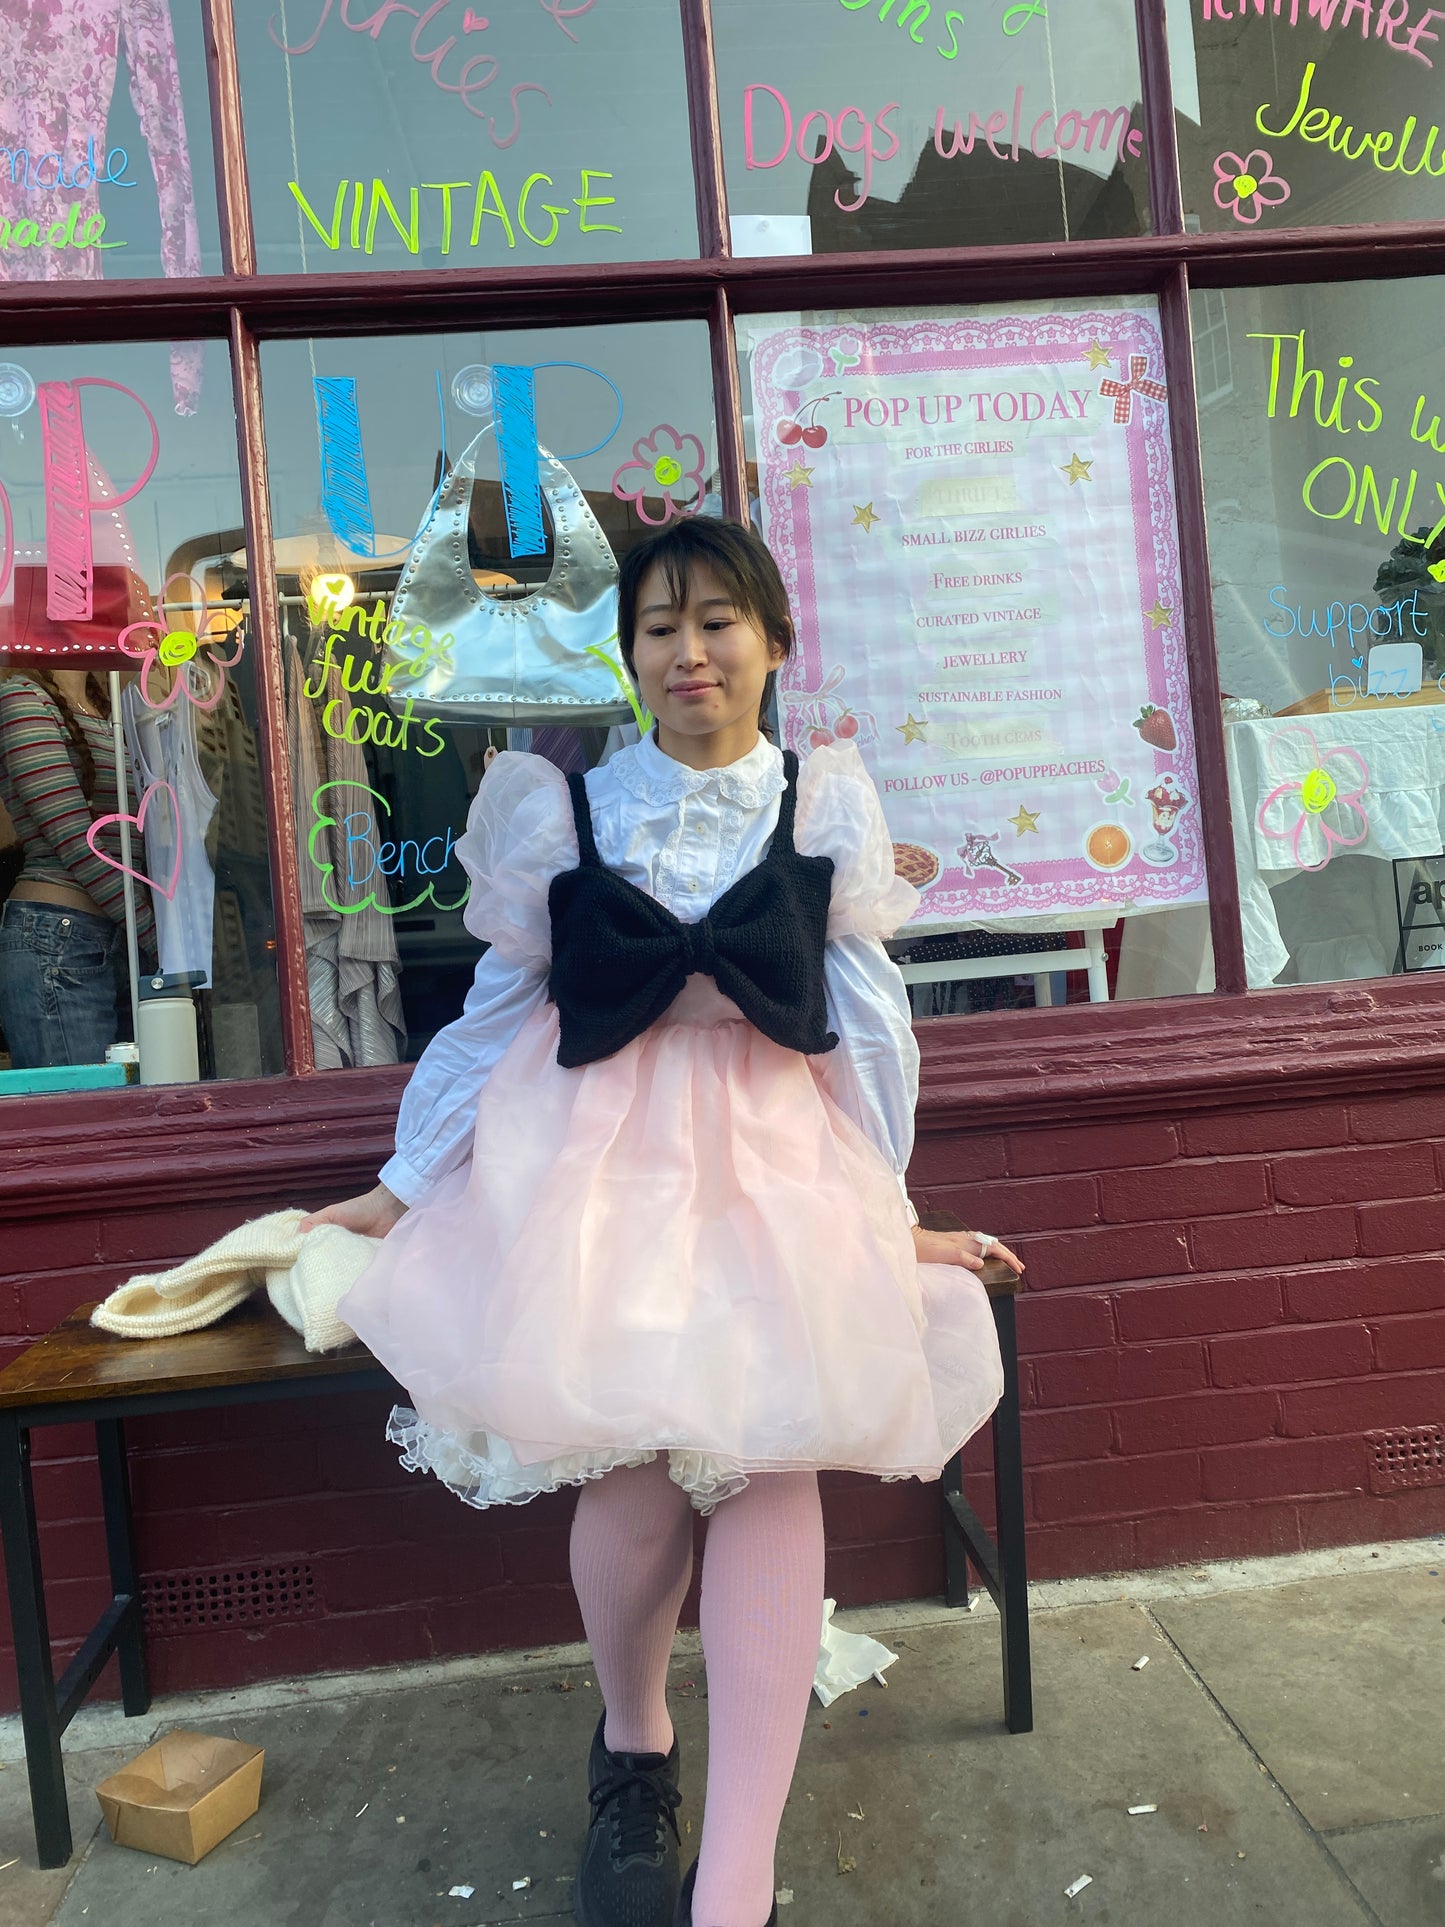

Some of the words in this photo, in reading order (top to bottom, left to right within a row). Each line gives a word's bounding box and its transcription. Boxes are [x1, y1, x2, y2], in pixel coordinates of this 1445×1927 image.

[1255, 62, 1445, 177] Jewell
[744, 83, 900, 212] Dogs
[934, 85, 1144, 163] welcome
[288, 170, 623, 254] VINTAGE
[843, 396, 910, 427] POP
[916, 395, 962, 424] UP
[969, 390, 1092, 422] TODAY
[1246, 329, 1383, 434] This
[313, 361, 623, 559] UP
[905, 447, 932, 460] FOR
[934, 444, 962, 457] THE
[964, 440, 1014, 455] GIRLIES
[901, 532, 950, 547] SMALL
[954, 529, 986, 543] BIZZ
[989, 525, 1047, 540] GIRLIES
[306, 579, 456, 678] vintage
[916, 613, 980, 628] CURATED
[983, 608, 1042, 622] VINTAGE
[1264, 585, 1429, 648] Support
[303, 634, 411, 699] fur
[942, 651, 1028, 669] JEWELLERY
[1329, 657, 1416, 706] bizz
[918, 690, 1003, 703] SUSTAINABLE
[1006, 689, 1062, 701] FASHION
[322, 698, 445, 757] coats
[884, 775, 947, 793] FOLLOW
[951, 773, 969, 786] US
[980, 760, 1106, 786] @POPUPPEACHES
[1418, 943, 1444, 952] BOOK
